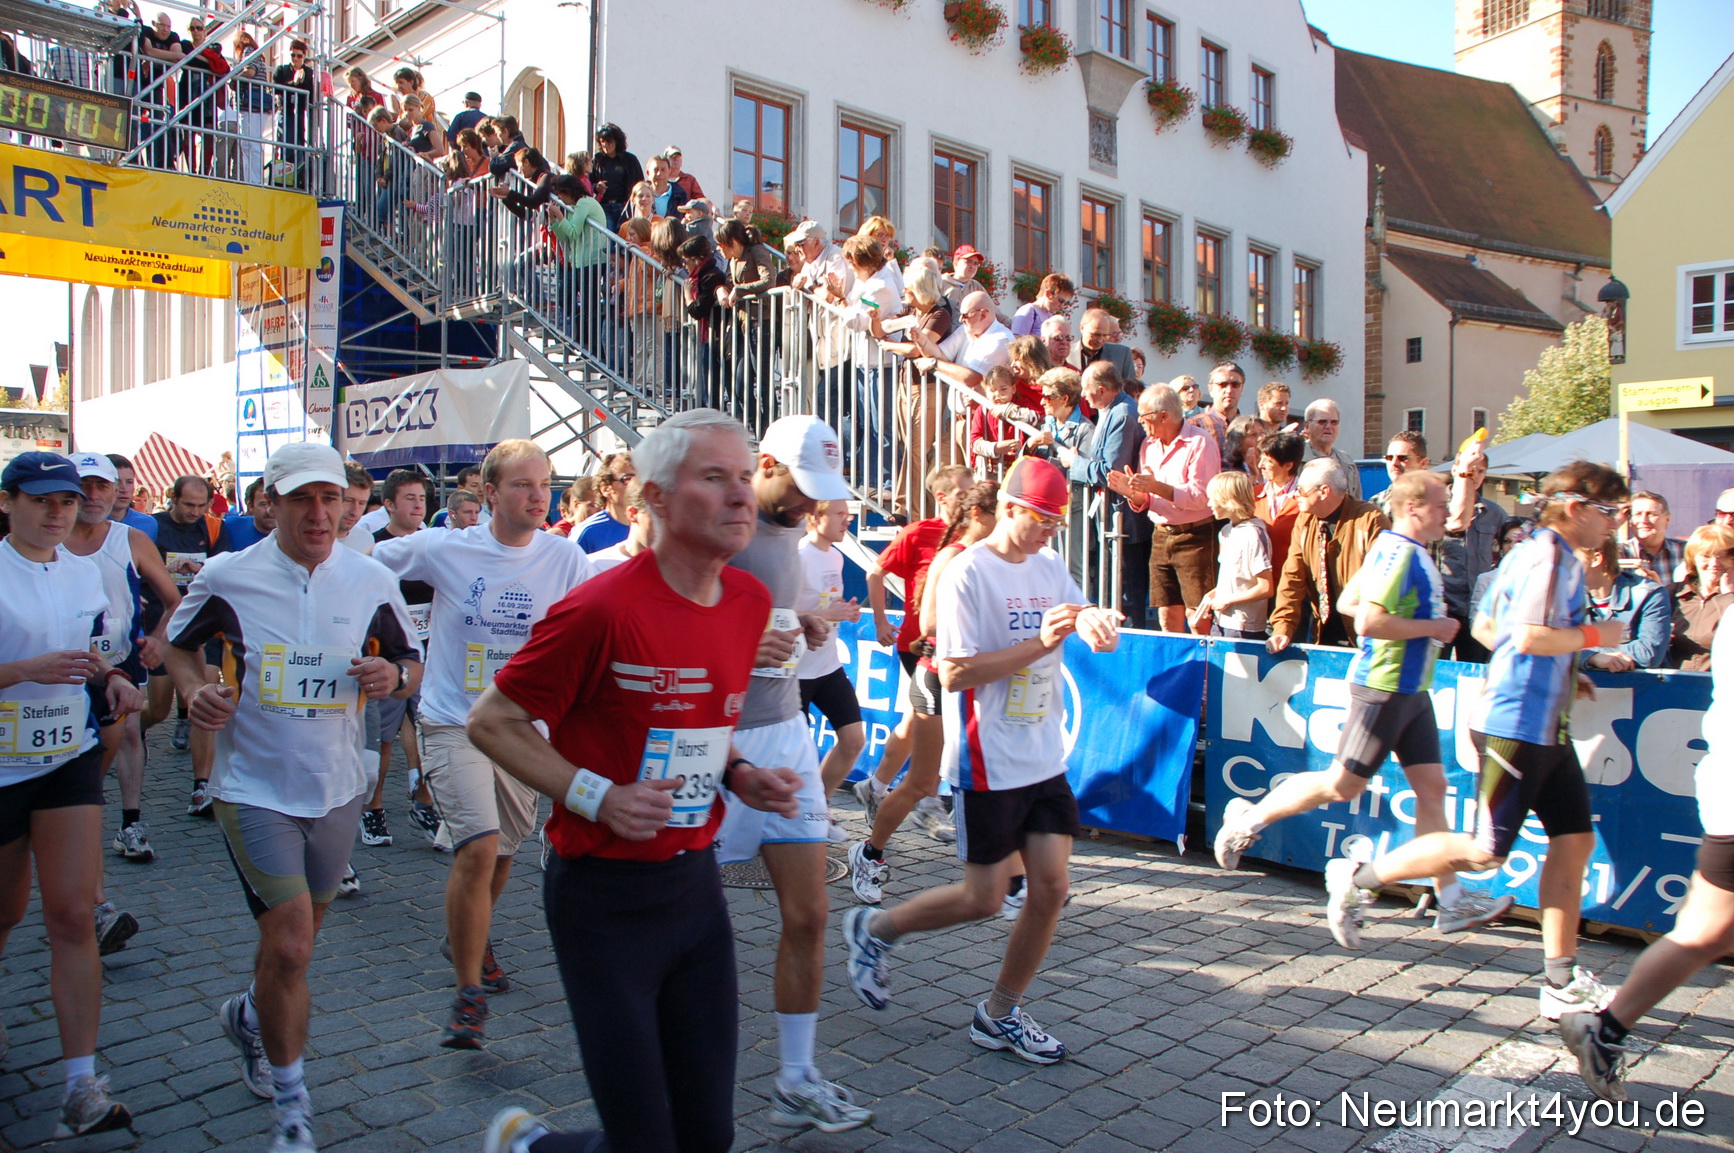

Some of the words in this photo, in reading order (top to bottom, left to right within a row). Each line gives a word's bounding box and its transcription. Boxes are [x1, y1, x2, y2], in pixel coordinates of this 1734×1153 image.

[0, 164, 108, 228] RT
[151, 215, 227, 235] Neumarkter
[230, 224, 286, 243] Stadtlauf
[84, 252, 154, 268] Neumarkter
[155, 260, 205, 275] Stadtlauf
[1622, 384, 1696, 397] Startnummern-
[1637, 396, 1679, 407] ausgabe
[497, 601, 534, 610] 16.09.2007
[480, 619, 530, 630] Neumarkter
[490, 627, 529, 637] Stadtlauf
[288, 651, 323, 667] Josef
[265, 671, 272, 682] B
[297, 678, 338, 699] 171
[23, 704, 71, 720] Stefanie
[31, 725, 73, 748] 815
[675, 738, 710, 757] Horst
